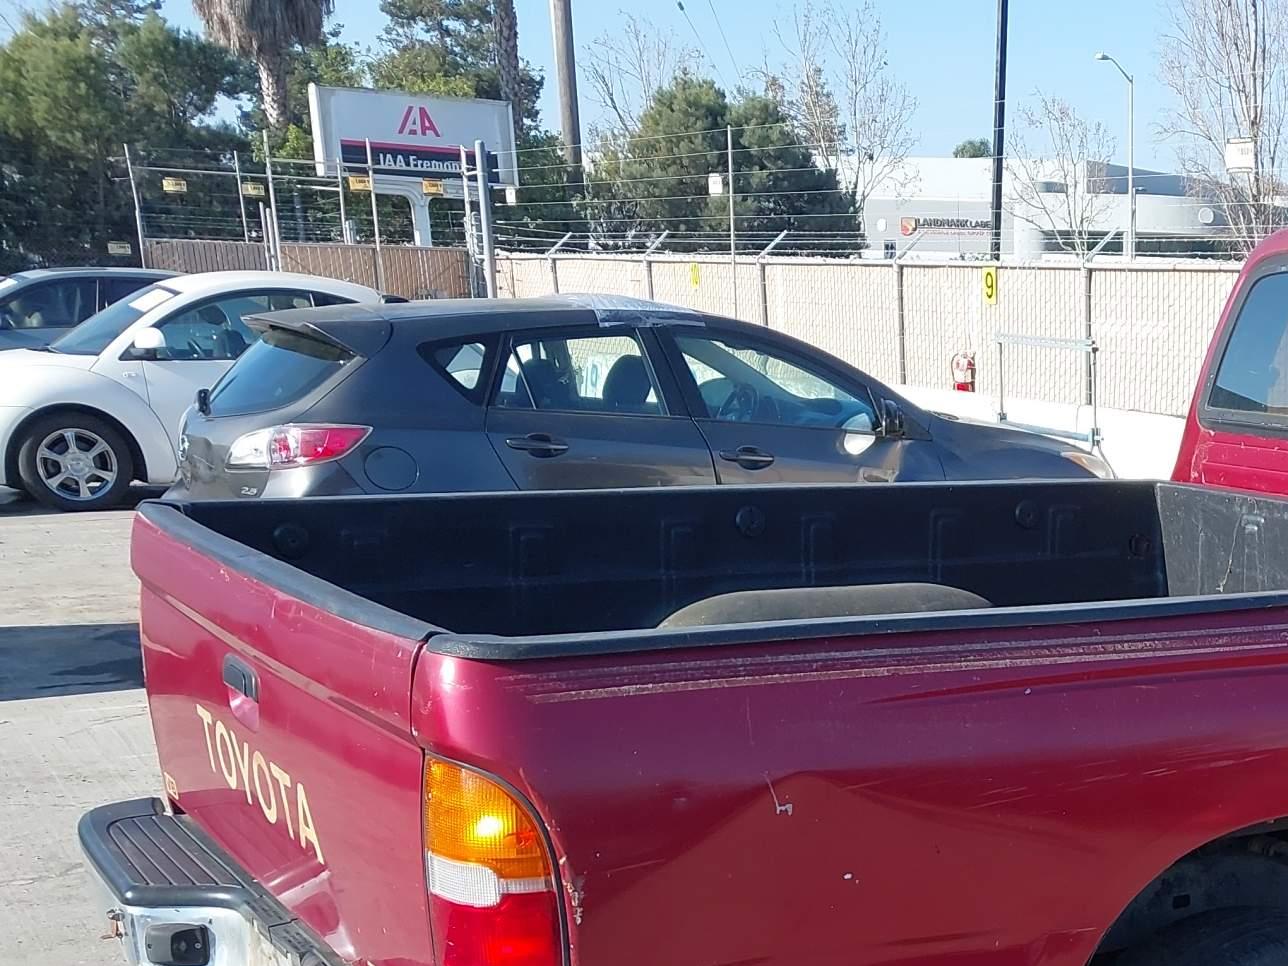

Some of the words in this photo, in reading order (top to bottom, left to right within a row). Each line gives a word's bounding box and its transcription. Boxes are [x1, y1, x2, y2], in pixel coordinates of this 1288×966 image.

[379, 153, 405, 167] IAA
[409, 155, 462, 172] Fremon
[917, 217, 969, 228] LANDMARK
[970, 220, 993, 229] LABE
[985, 271, 994, 299] 9
[196, 703, 325, 865] TOYOTA
